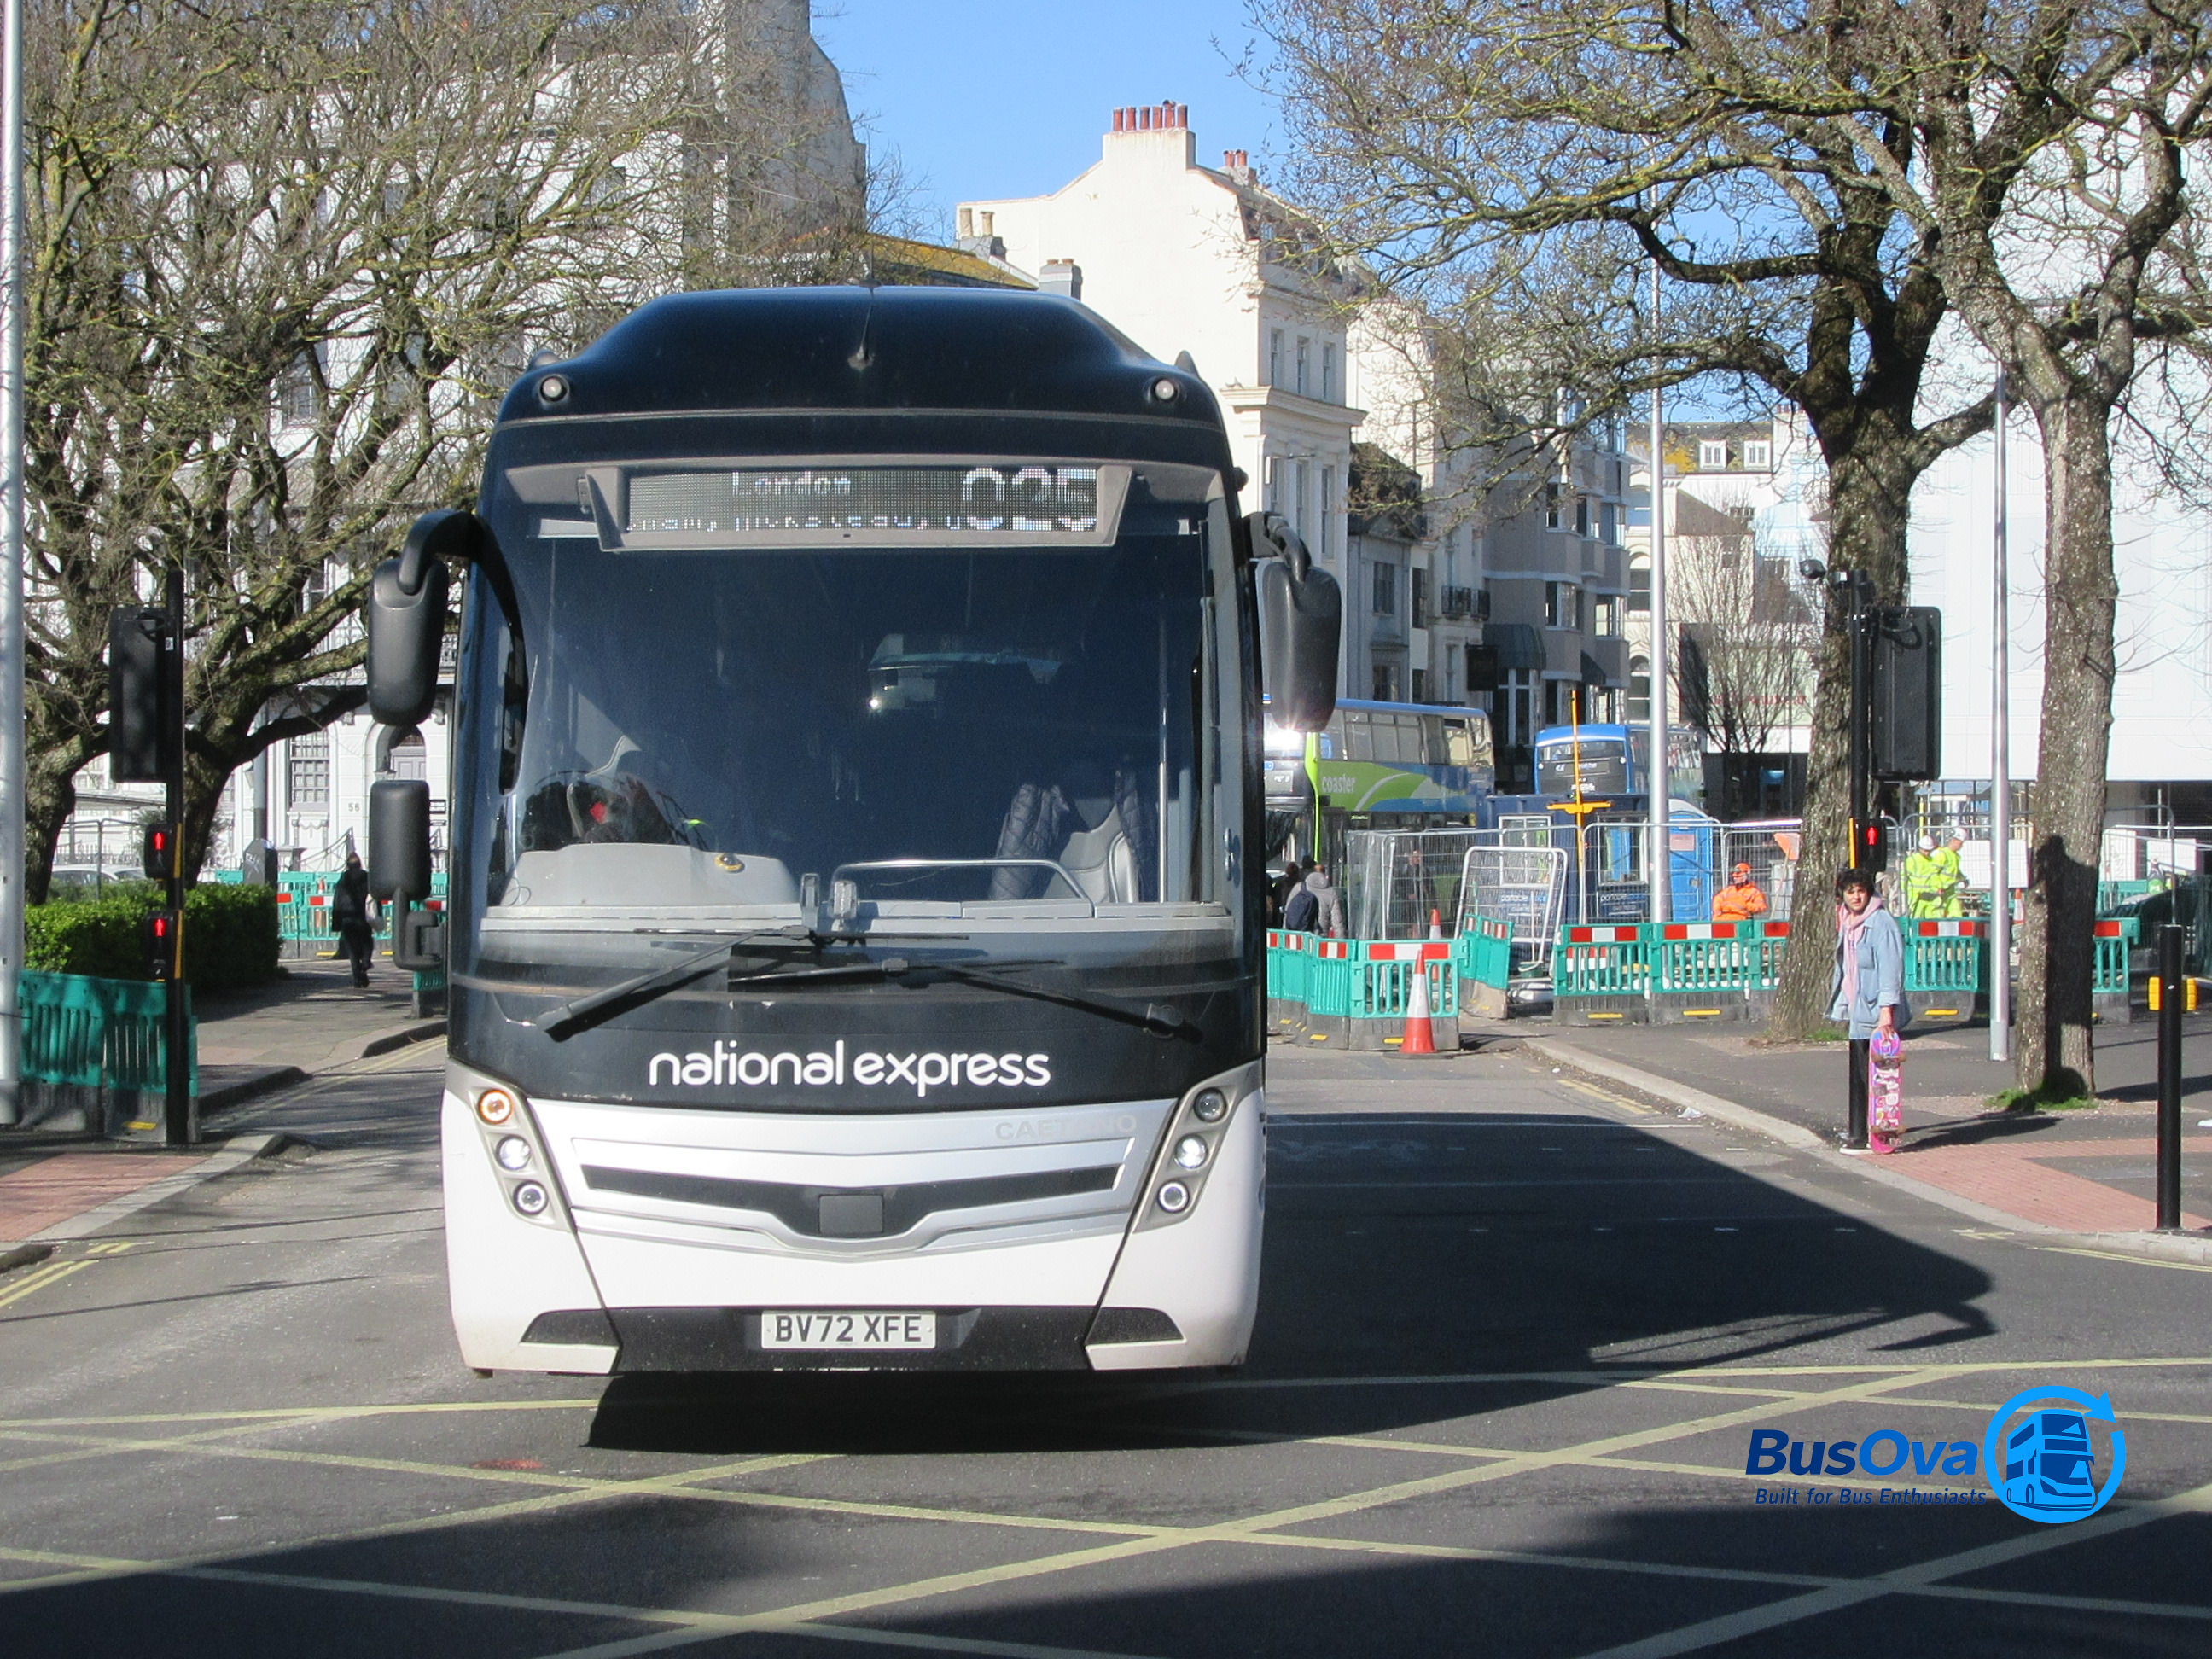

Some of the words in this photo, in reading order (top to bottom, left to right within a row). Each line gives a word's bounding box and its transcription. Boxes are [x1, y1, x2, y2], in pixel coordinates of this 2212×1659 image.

[731, 471, 852, 496] London
[963, 467, 1097, 532] 025
[1322, 773, 1355, 794] coaster
[348, 803, 360, 812] 56
[649, 1040, 844, 1086] national
[853, 1052, 1051, 1097] express
[775, 1315, 853, 1342] BV72
[864, 1315, 922, 1342] XFE
